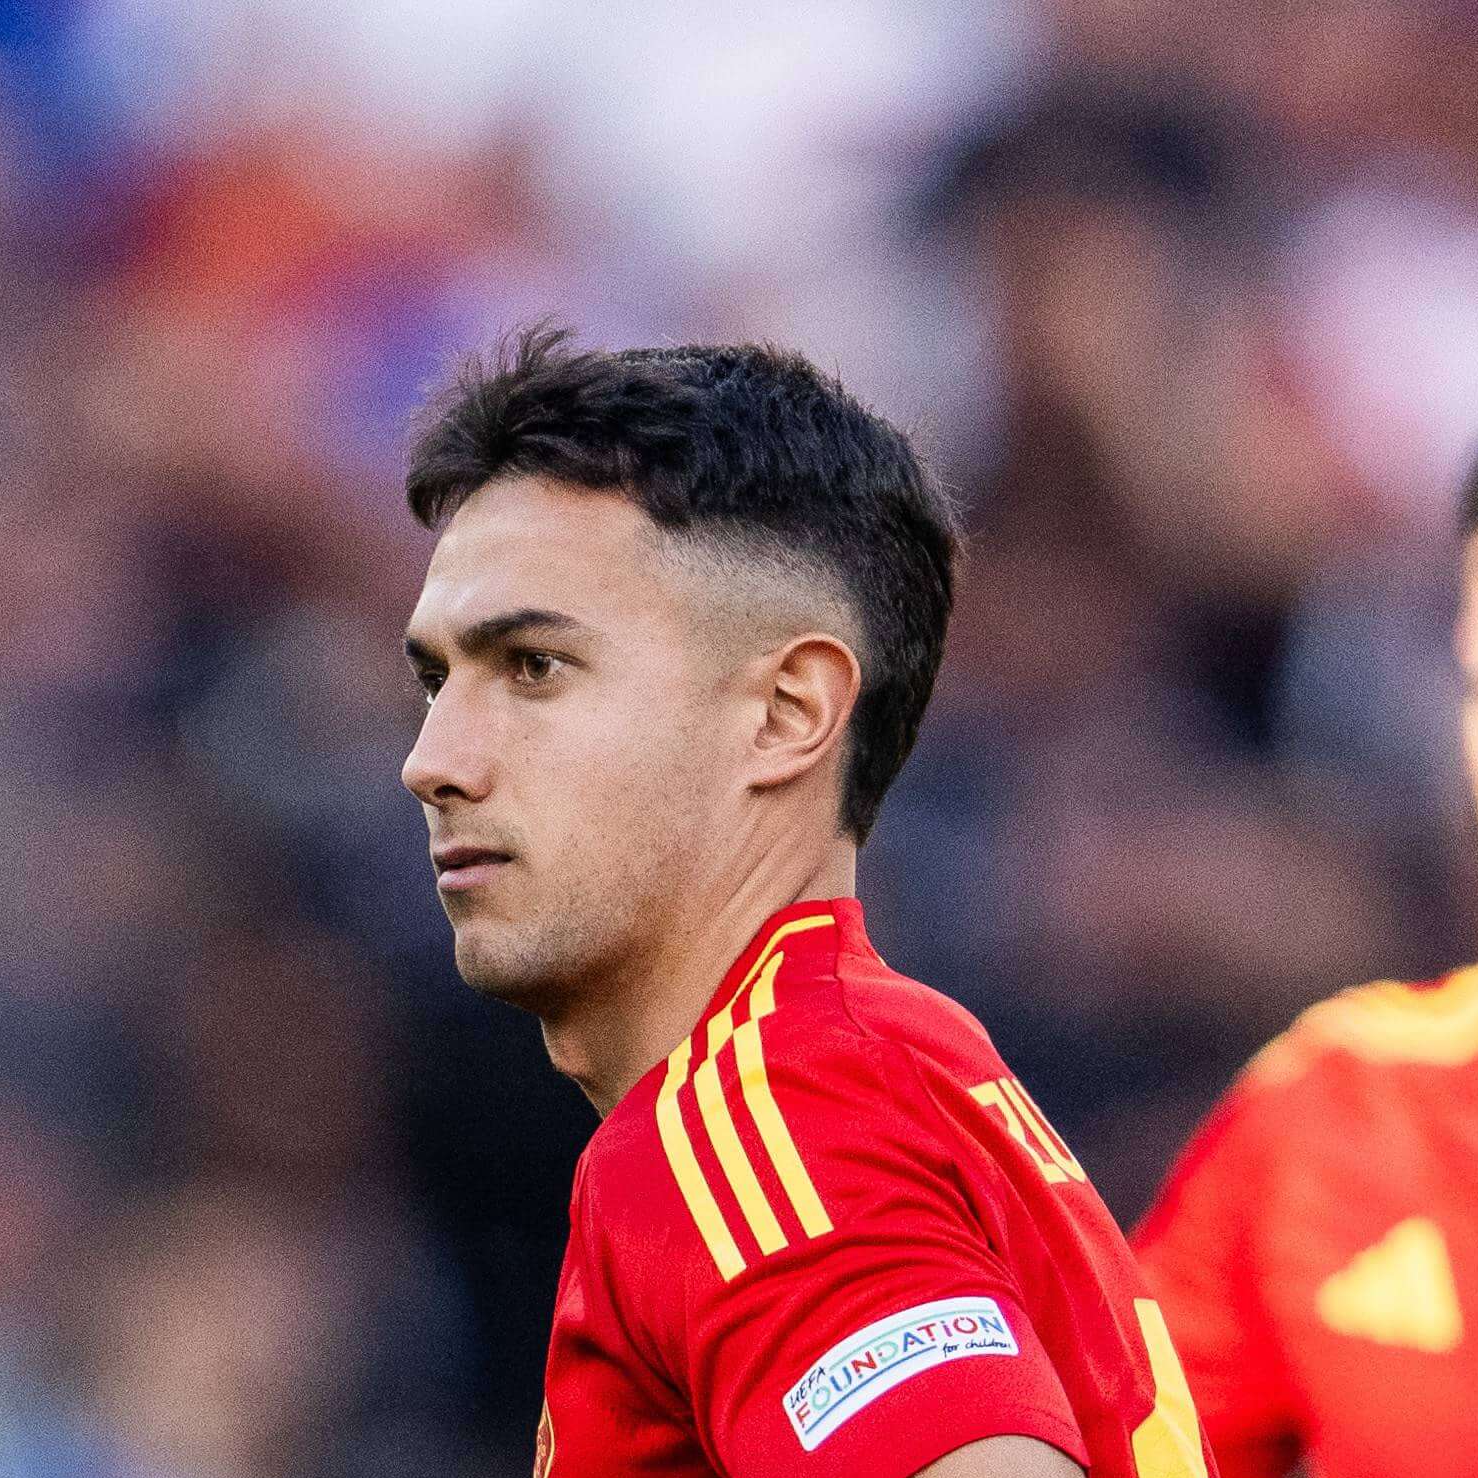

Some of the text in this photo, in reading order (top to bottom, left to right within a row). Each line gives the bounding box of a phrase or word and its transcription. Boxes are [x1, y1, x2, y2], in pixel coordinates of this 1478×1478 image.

[942, 1338, 1011, 1358] for children
[790, 1366, 826, 1408] UEFA
